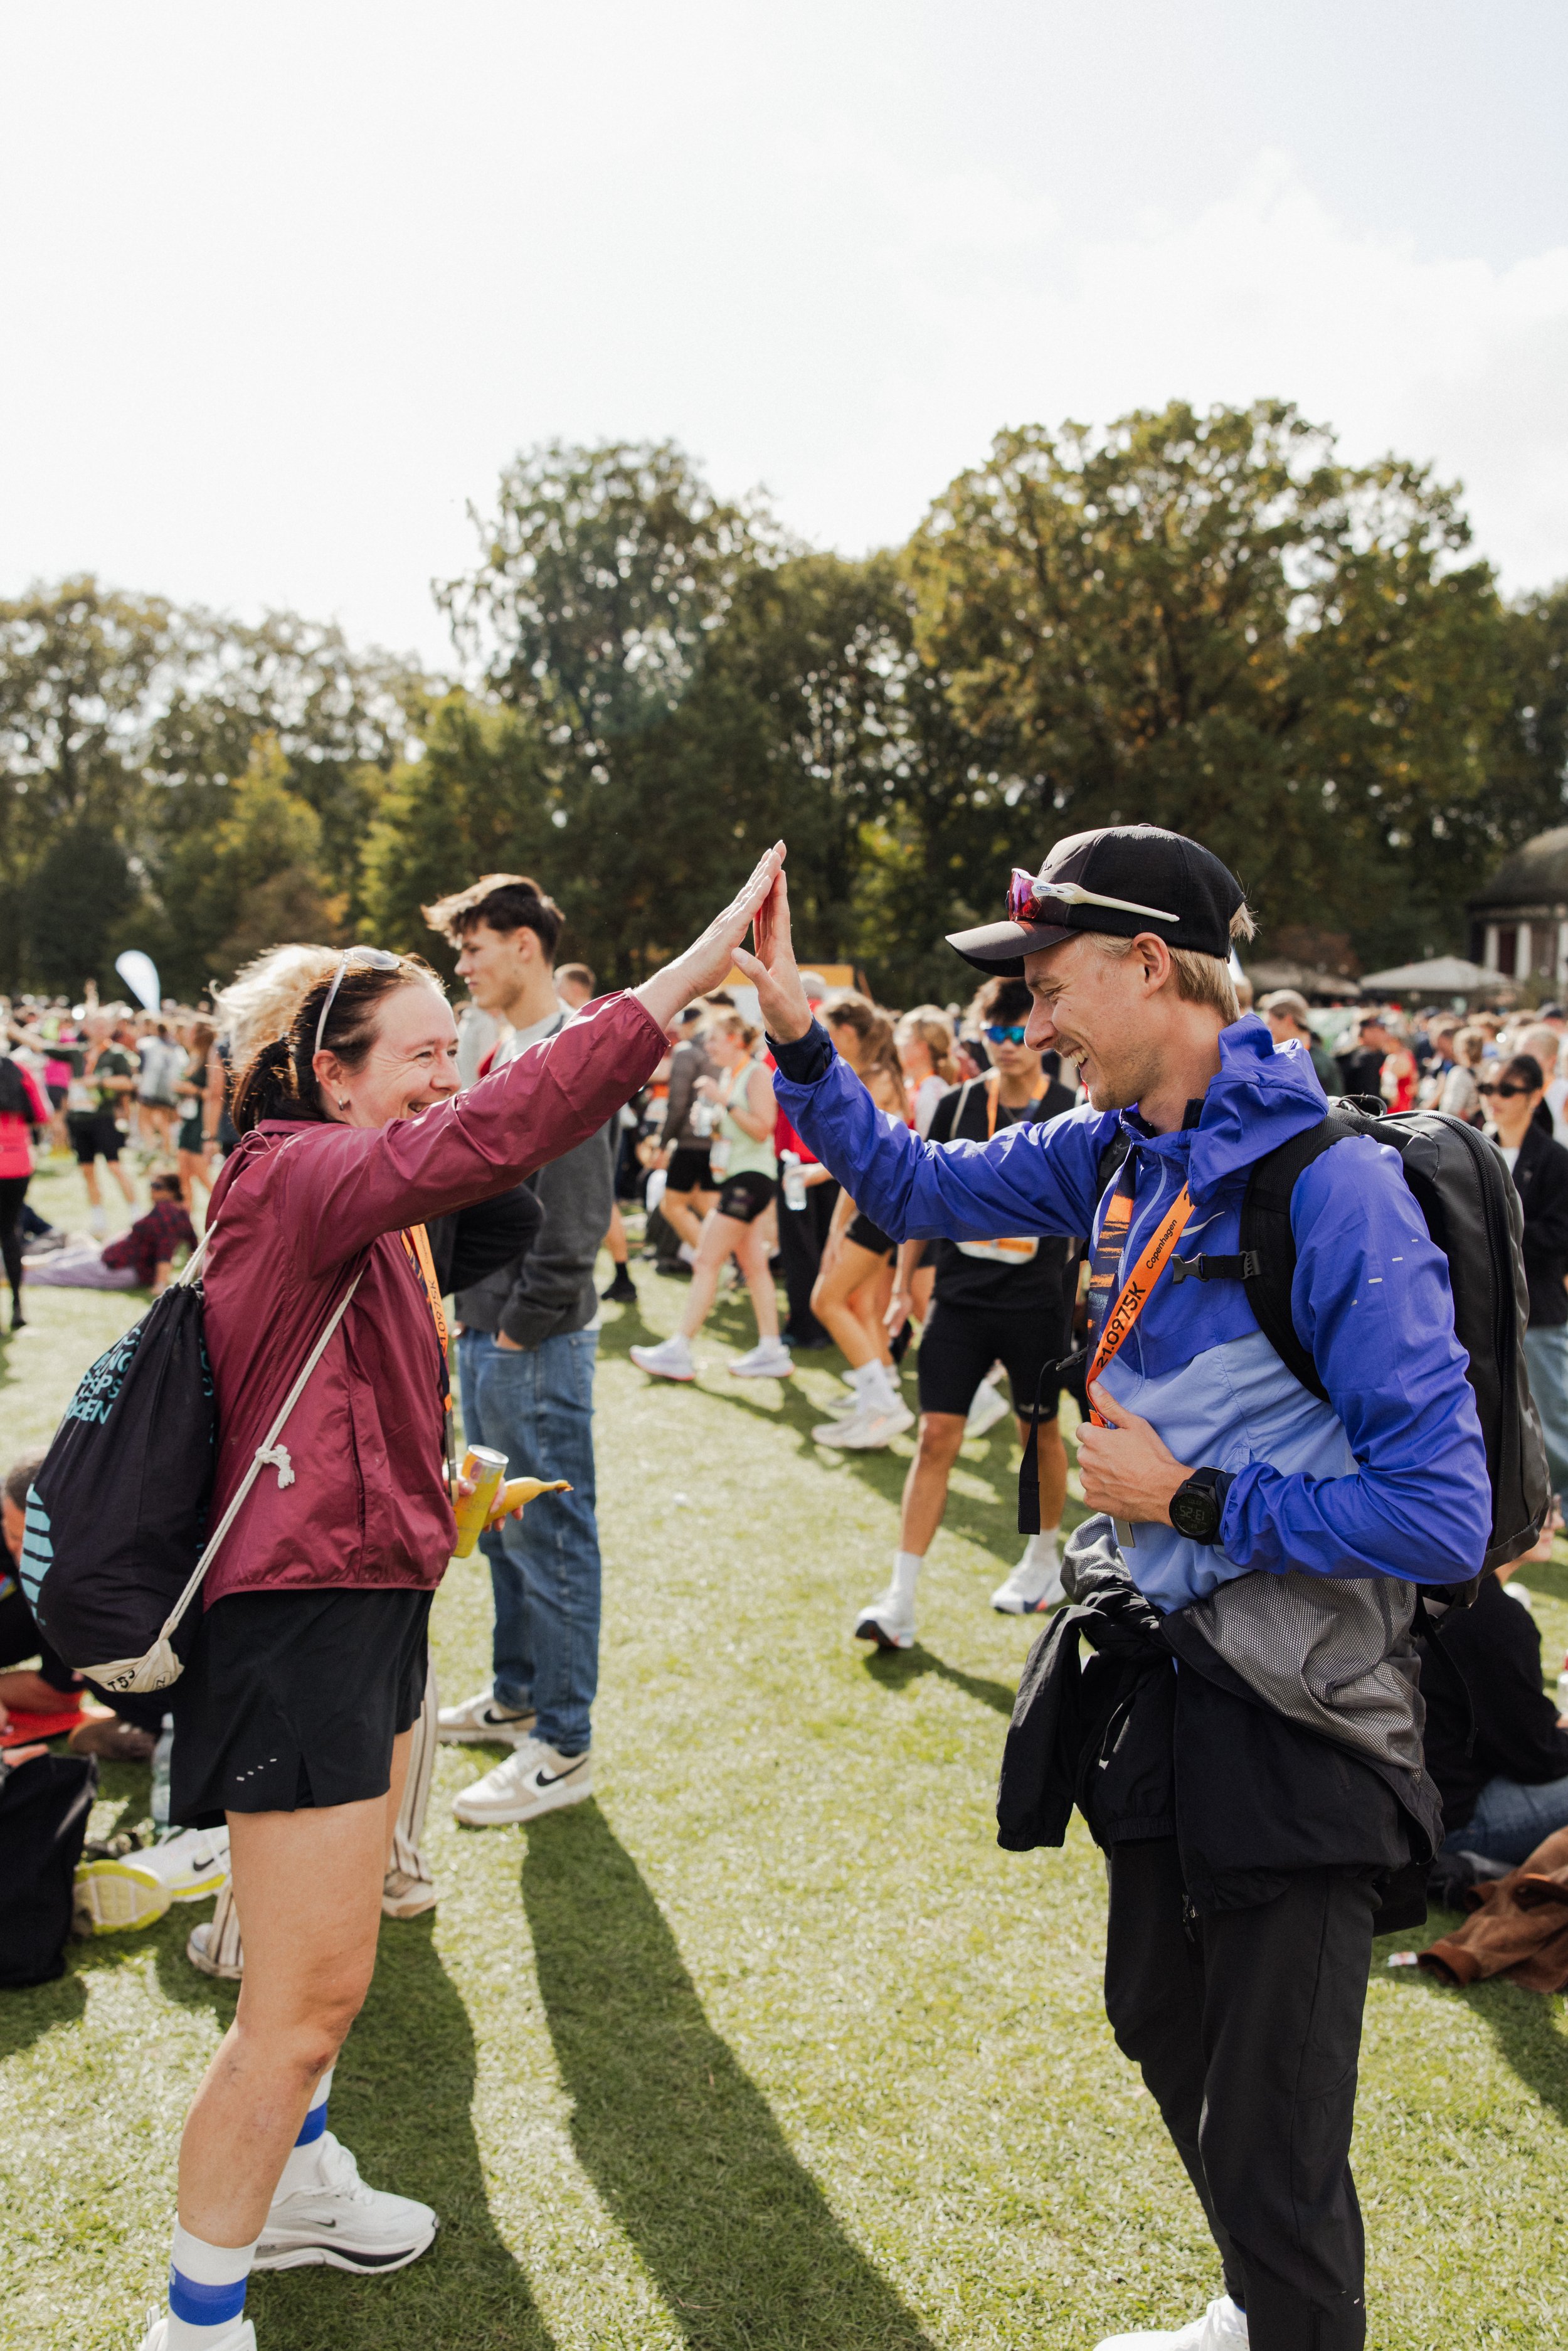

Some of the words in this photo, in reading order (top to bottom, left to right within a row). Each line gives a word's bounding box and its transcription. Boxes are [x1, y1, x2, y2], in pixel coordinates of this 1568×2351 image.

[1146, 1219, 1177, 1270] Copenhagen
[1096, 1281, 1146, 1368] 21.0975K
[1179, 1505, 1205, 1521] 13:25
